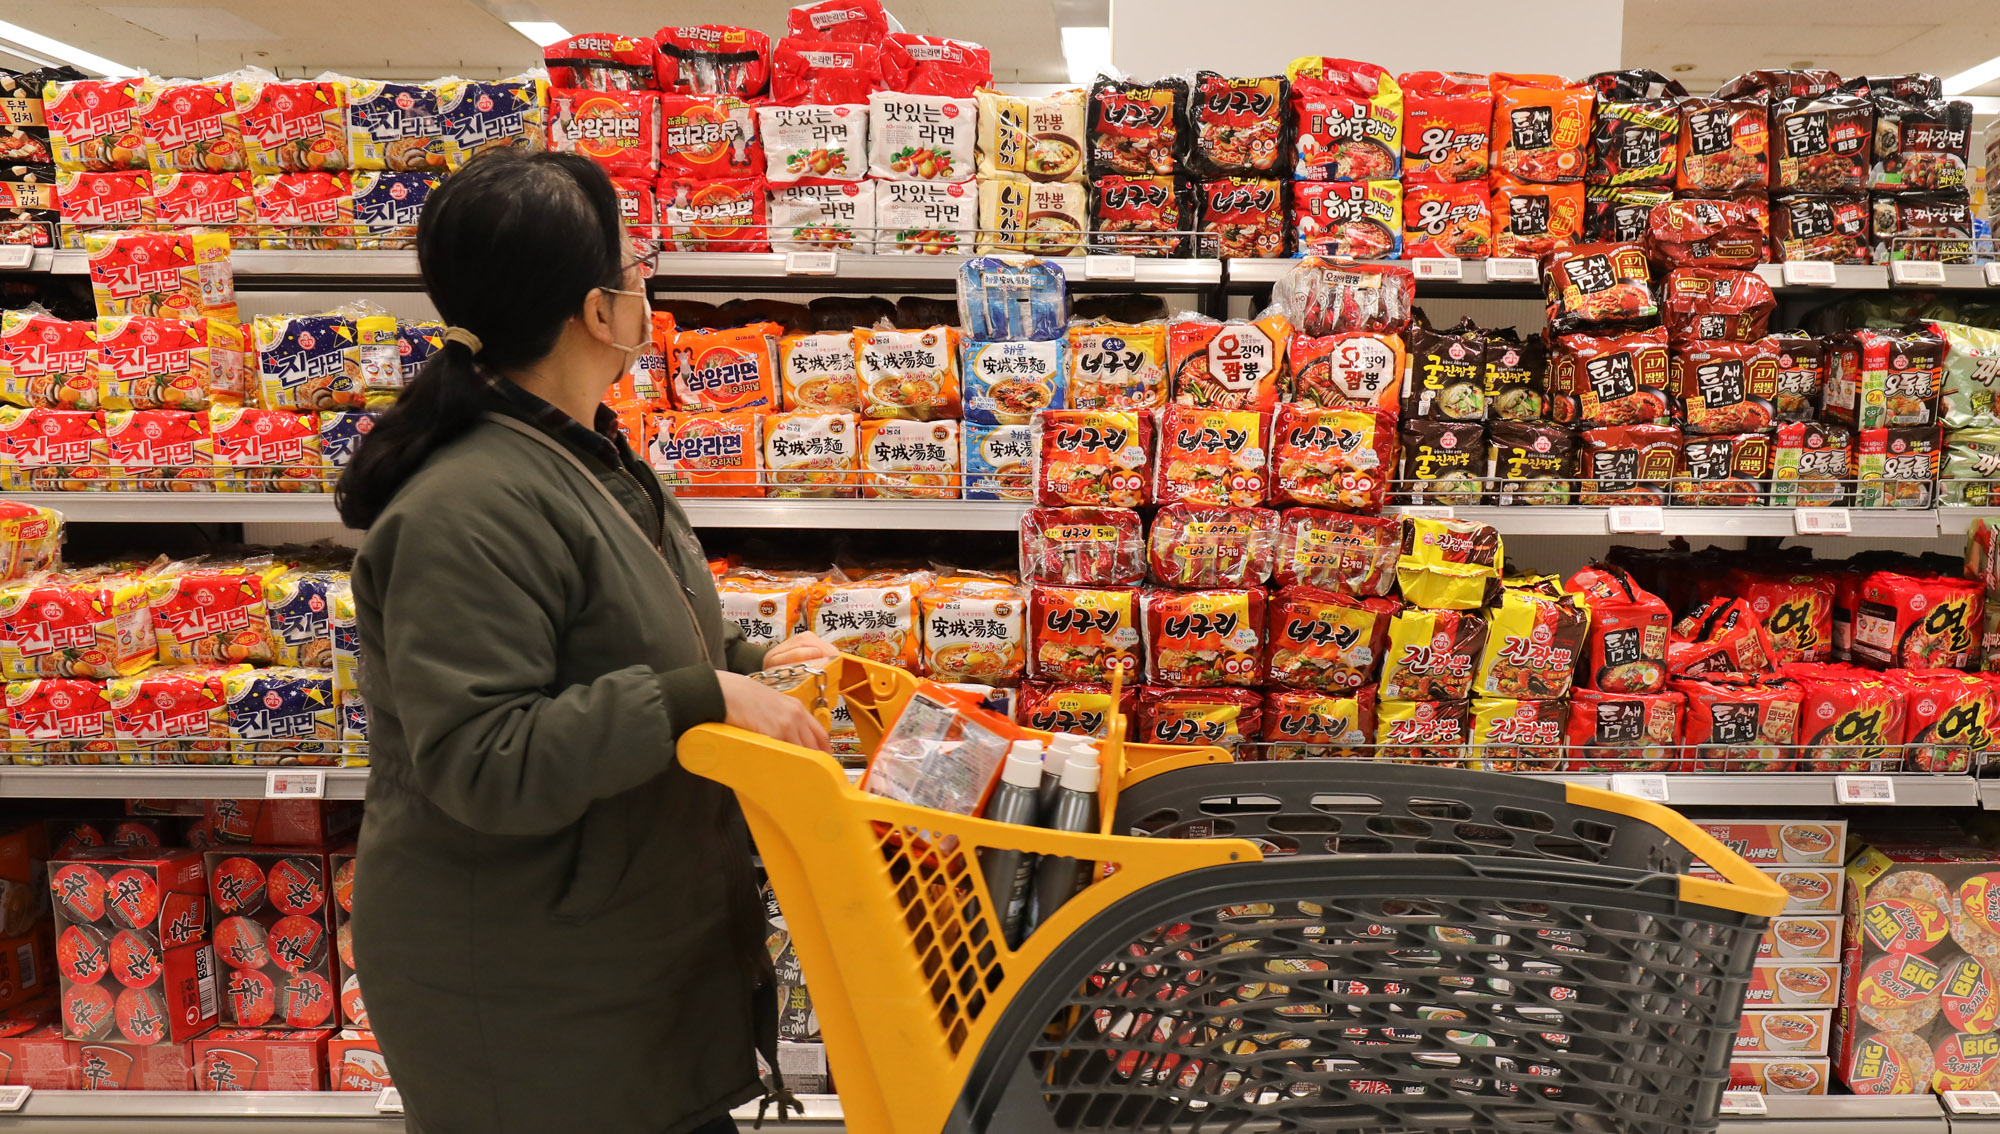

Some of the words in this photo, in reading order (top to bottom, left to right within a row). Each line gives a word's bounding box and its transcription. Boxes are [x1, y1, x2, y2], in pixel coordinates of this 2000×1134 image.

[812, 12, 846, 24] 맛있는라면
[6, 100, 28, 110] 두부
[1209, 91, 1274, 116] 너구리
[12, 112, 33, 123] 김치
[667, 116, 689, 125] 매운맛
[1033, 113, 1064, 132] 짬뽕
[1325, 103, 1396, 141] 해물라면
[1375, 105, 1399, 123] NEW
[1837, 110, 1860, 120] CHAI
[61, 109, 132, 145] 진라면
[153, 115, 223, 152] 진라면
[255, 112, 325, 150] 진라면
[454, 111, 525, 151] 진라면
[566, 117, 639, 139] 삼양라면
[667, 120, 738, 147] 삼양라면
[812, 124, 848, 144] 라면
[919, 124, 954, 144] 라면
[1836, 128, 1855, 139] 매운
[617, 138, 639, 148] 매운맛
[1419, 128, 1485, 164] 왕뚜껑
[1838, 140, 1857, 152] 짜장
[1905, 129, 1916, 146] 팔도
[1916, 129, 1964, 150] 짜장면
[1094, 149, 1114, 160] 5개입
[15, 185, 38, 195] 두부
[786, 185, 842, 201] 맛있는
[890, 184, 947, 203] 맛있는
[1106, 186, 1169, 210] 너구리
[1371, 186, 1396, 203] NEW
[20, 195, 39, 206] 김치
[681, 198, 754, 222] 삼양라면
[820, 202, 855, 219] 라면
[1034, 191, 1065, 210] 짬뽕
[1323, 186, 1393, 222] 해물라면
[925, 204, 959, 222] 라면
[999, 184, 1023, 245] 나가사끼
[1416, 201, 1481, 236] 왕뚜껑
[1841, 209, 1858, 220] 매운
[1622, 256, 1642, 267] 고기
[106, 264, 181, 299] 진라면
[1623, 268, 1645, 279] 짬뽕
[1003, 344, 1026, 355] 해물
[1106, 340, 1123, 349] 순한
[1217, 334, 1264, 362] 오징어
[11, 344, 88, 378] 진라면
[113, 345, 190, 381] 진라면
[277, 350, 344, 389] 진라면
[865, 351, 935, 372] 安城湯麵
[983, 357, 1046, 374] 安城湯麵
[1081, 351, 1145, 376] 너구리
[1644, 358, 1665, 369] 고기
[689, 361, 758, 391] 삼양라면
[1644, 372, 1665, 383] 짬뽕
[1754, 367, 1775, 379] 고기
[176, 380, 195, 390] 매운맛
[1698, 364, 1742, 405] 틈새라면
[1753, 382, 1774, 394] 짬뽕
[1076, 398, 1096, 408] 5개입
[887, 428, 901, 436] 농심
[1084, 417, 1103, 427] 얼큰한
[1205, 418, 1224, 428] 얼큰한
[665, 434, 741, 461] 삼양라면
[773, 436, 843, 457] 安城湯麵
[1056, 427, 1129, 453] 너구리
[1177, 427, 1248, 454] 너구리
[710, 455, 741, 468] 오리지널
[875, 442, 945, 462] 安城湯麵
[1741, 446, 1762, 457] 고기
[1508, 448, 1562, 480] 굴진짬뽕
[1649, 457, 1671, 467] 고기
[1739, 460, 1761, 472] 짬뽕
[1047, 481, 1069, 492] 5개입
[1167, 481, 1189, 492] 5개입
[1097, 528, 1114, 537] 5개입
[1437, 533, 1473, 553] 진짬뽕
[1310, 555, 1337, 566] 너구리
[1049, 597, 1064, 605] 농심
[170, 606, 249, 643] 진라면
[821, 610, 900, 632] 安城湯麵
[1046, 607, 1120, 635] 너구리
[1165, 612, 1237, 640] 너구리
[1319, 612, 1339, 621] 얼큰한
[1769, 601, 1817, 650] 열
[932, 618, 1009, 639] 安城湯麵
[1287, 619, 1360, 650] 너구리
[1925, 603, 1972, 653] 열
[15, 620, 96, 658] 진라면
[1397, 644, 1472, 677] 진짬뽕
[1499, 635, 1572, 671] 진짬뽕
[1040, 662, 1062, 673] 5개입
[1160, 669, 1181, 680] 5개입
[1060, 699, 1078, 709] 얼큰한
[1920, 706, 1935, 715] 오뚜기
[129, 710, 209, 746] 진라면
[1031, 710, 1102, 734] 너구리
[1156, 718, 1226, 745] 너구리
[1280, 713, 1348, 738] 너구리
[1389, 718, 1461, 745] 진짬뽕
[1488, 717, 1560, 745] 진짬뽕
[1938, 701, 1992, 752] 열
[1834, 709, 1886, 758] 열
[1800, 831, 1823, 842] 김치
[1746, 848, 1779, 860] 사발면
[111, 875, 144, 908] 辛
[218, 874, 245, 909] 辛
[286, 877, 315, 909] 辛
[1797, 878, 1820, 888] 김치
[1795, 926, 1818, 937] 김치
[1868, 904, 1896, 943] BIG
[275, 935, 311, 963] 辛
[73, 945, 101, 978] 辛
[126, 947, 154, 981] 辛
[197, 948, 208, 979] 3538
[1796, 973, 1819, 983] 김치
[1901, 963, 1937, 993] BIG
[1952, 963, 1980, 997] BIG
[1782, 1020, 1808, 1031] 김치
[1963, 1038, 1999, 1057] BIG
[1861, 1043, 1883, 1078] BIG
[1945, 1055, 1983, 1074] 육개장
[1960, 1076, 1976, 1090] 20
